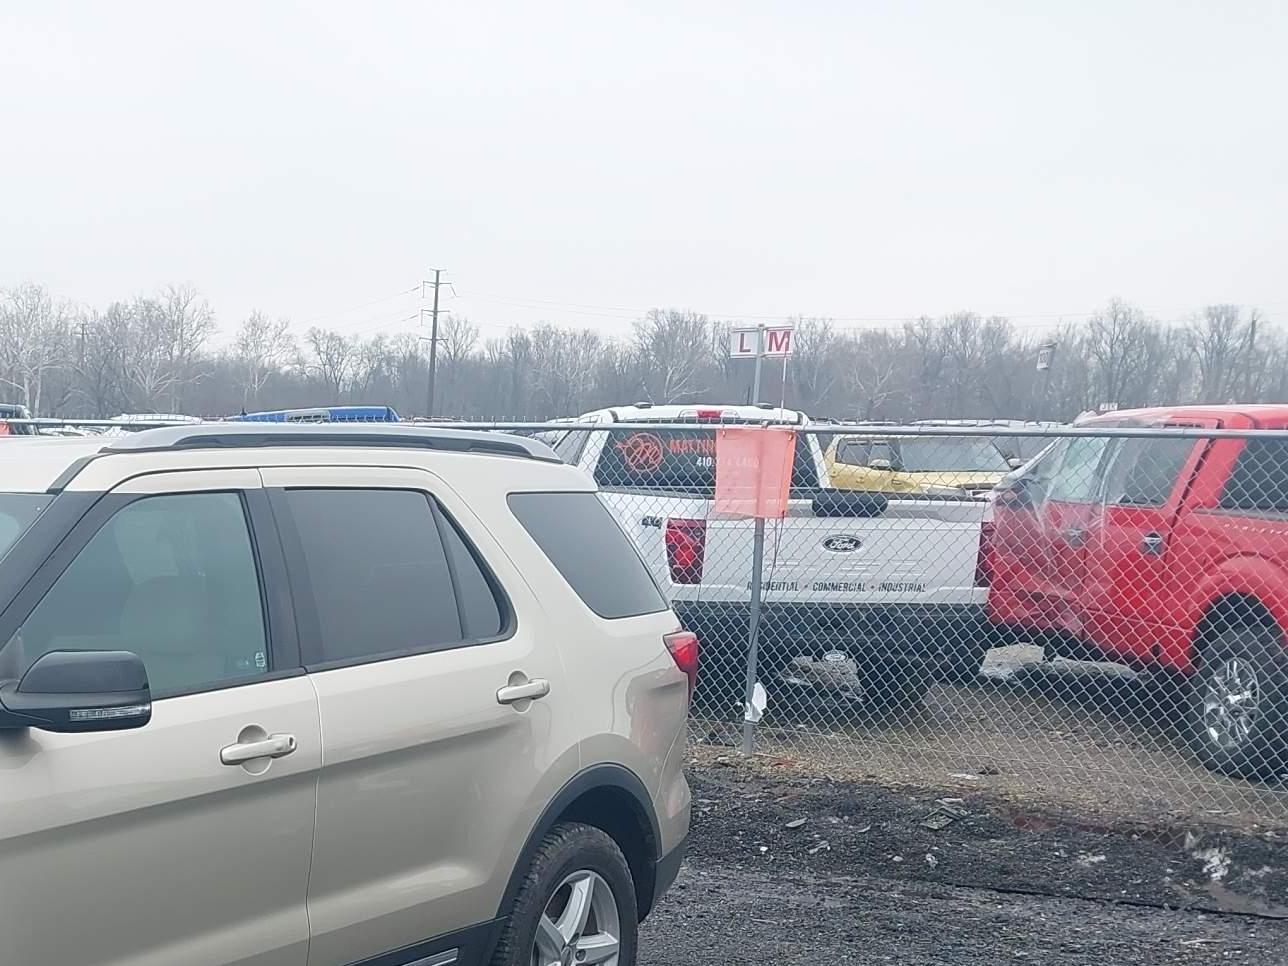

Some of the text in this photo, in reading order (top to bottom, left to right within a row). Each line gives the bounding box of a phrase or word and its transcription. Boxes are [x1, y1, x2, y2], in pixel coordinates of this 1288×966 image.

[739, 331, 791, 352] L M
[747, 581, 927, 593] RIDENTIAL COMMERCIAL INDUSTRIAL
